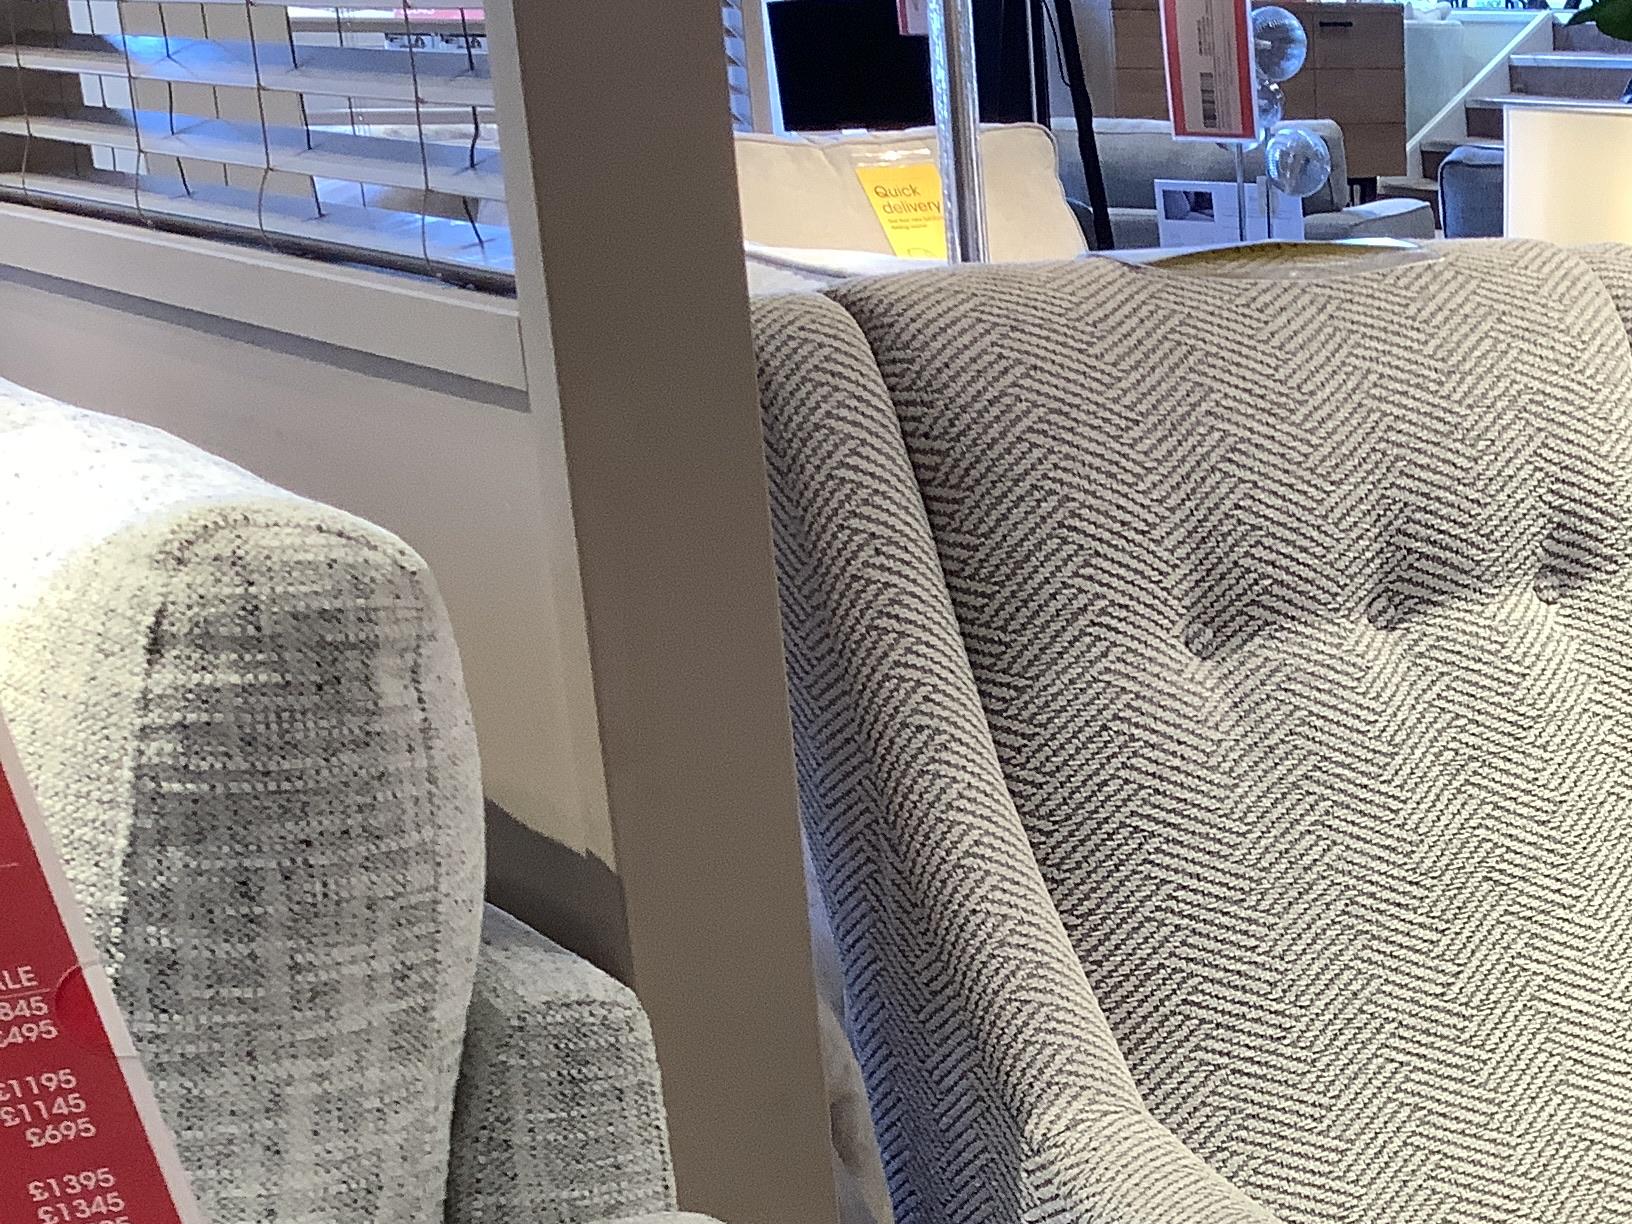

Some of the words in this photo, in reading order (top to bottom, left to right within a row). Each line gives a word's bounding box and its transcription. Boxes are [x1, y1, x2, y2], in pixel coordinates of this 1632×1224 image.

[874, 184, 921, 198] Quick
[882, 200, 941, 214] delivery
[0, 1093, 86, 1127] £1145
[25, 1117, 96, 1148] £695
[28, 1167, 115, 1201] £1395
